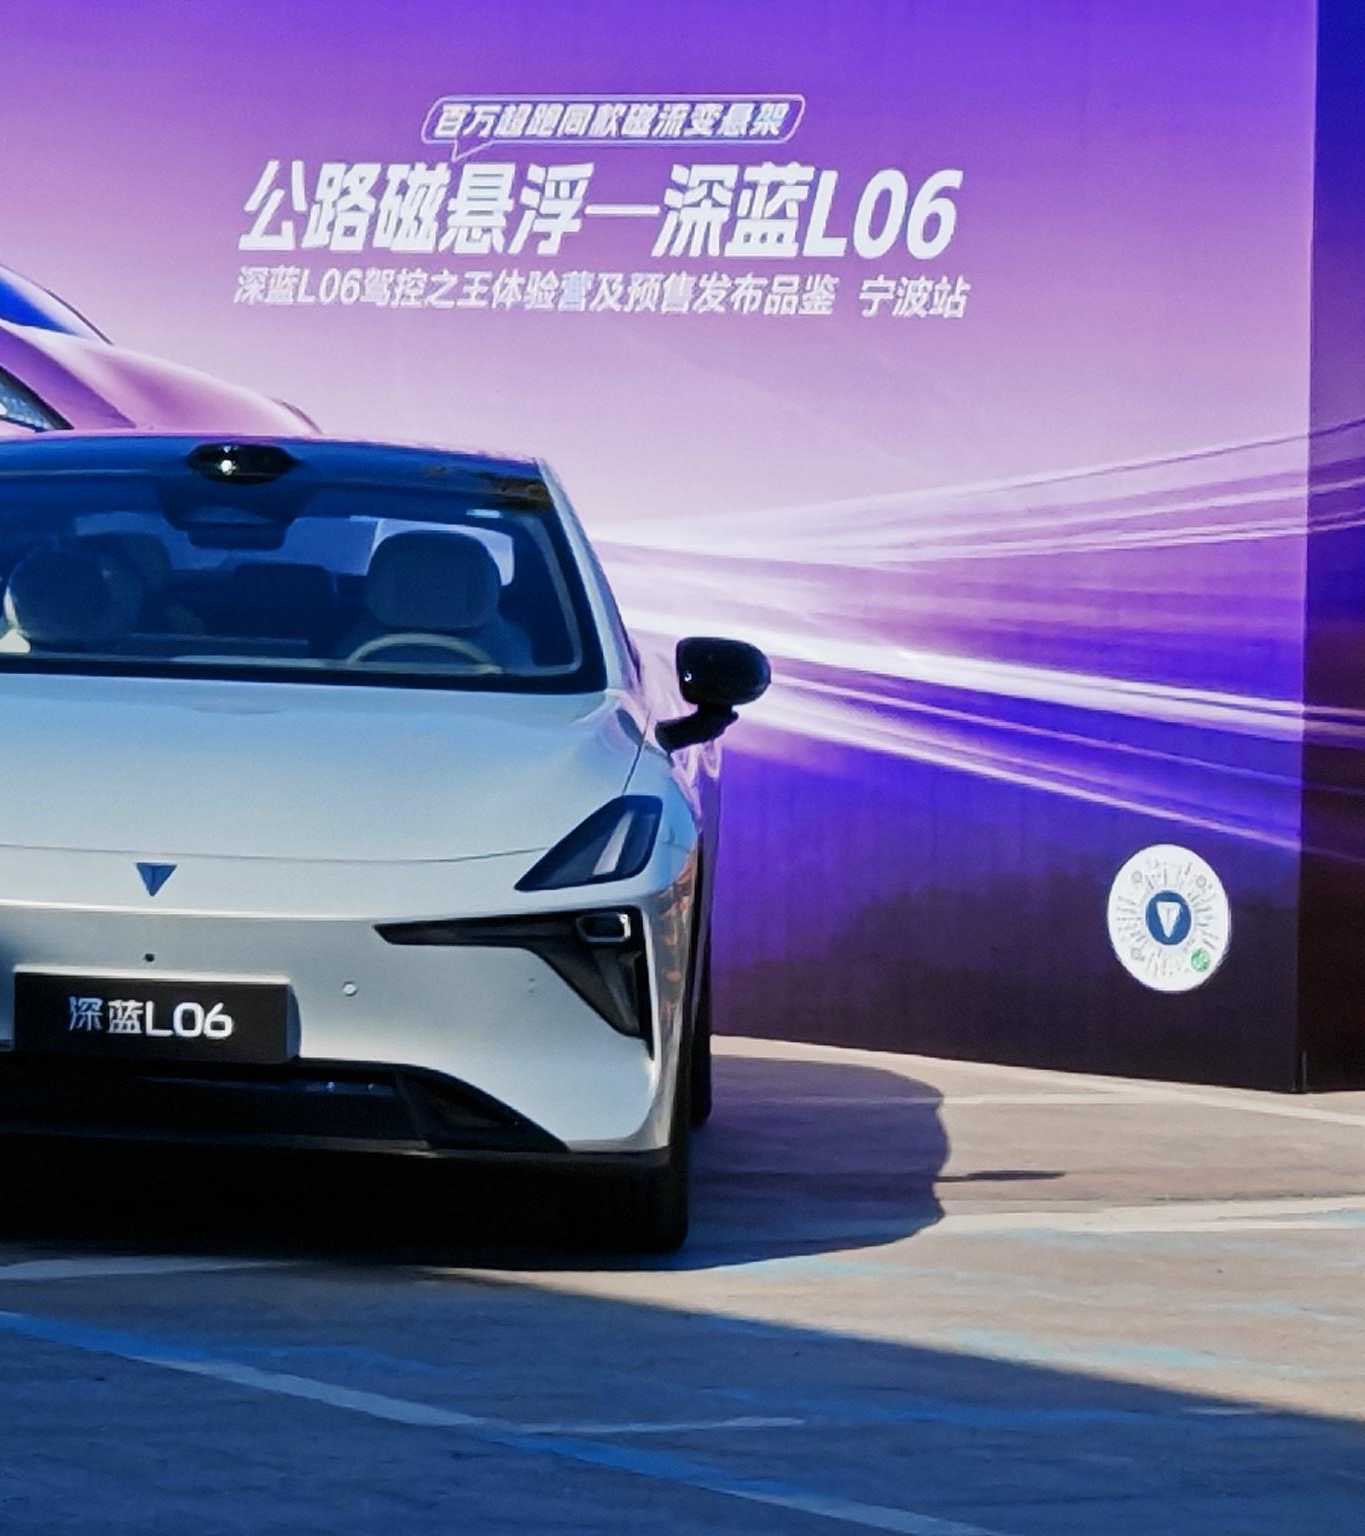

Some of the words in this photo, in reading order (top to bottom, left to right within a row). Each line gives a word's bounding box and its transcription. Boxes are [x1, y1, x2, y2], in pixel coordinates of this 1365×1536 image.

[232, 265, 840, 316] 深蓝L06驾控之王体验营及预售发布品鉴
[858, 274, 972, 319] 宁波站
[69, 996, 235, 1040] 深蓝L06
